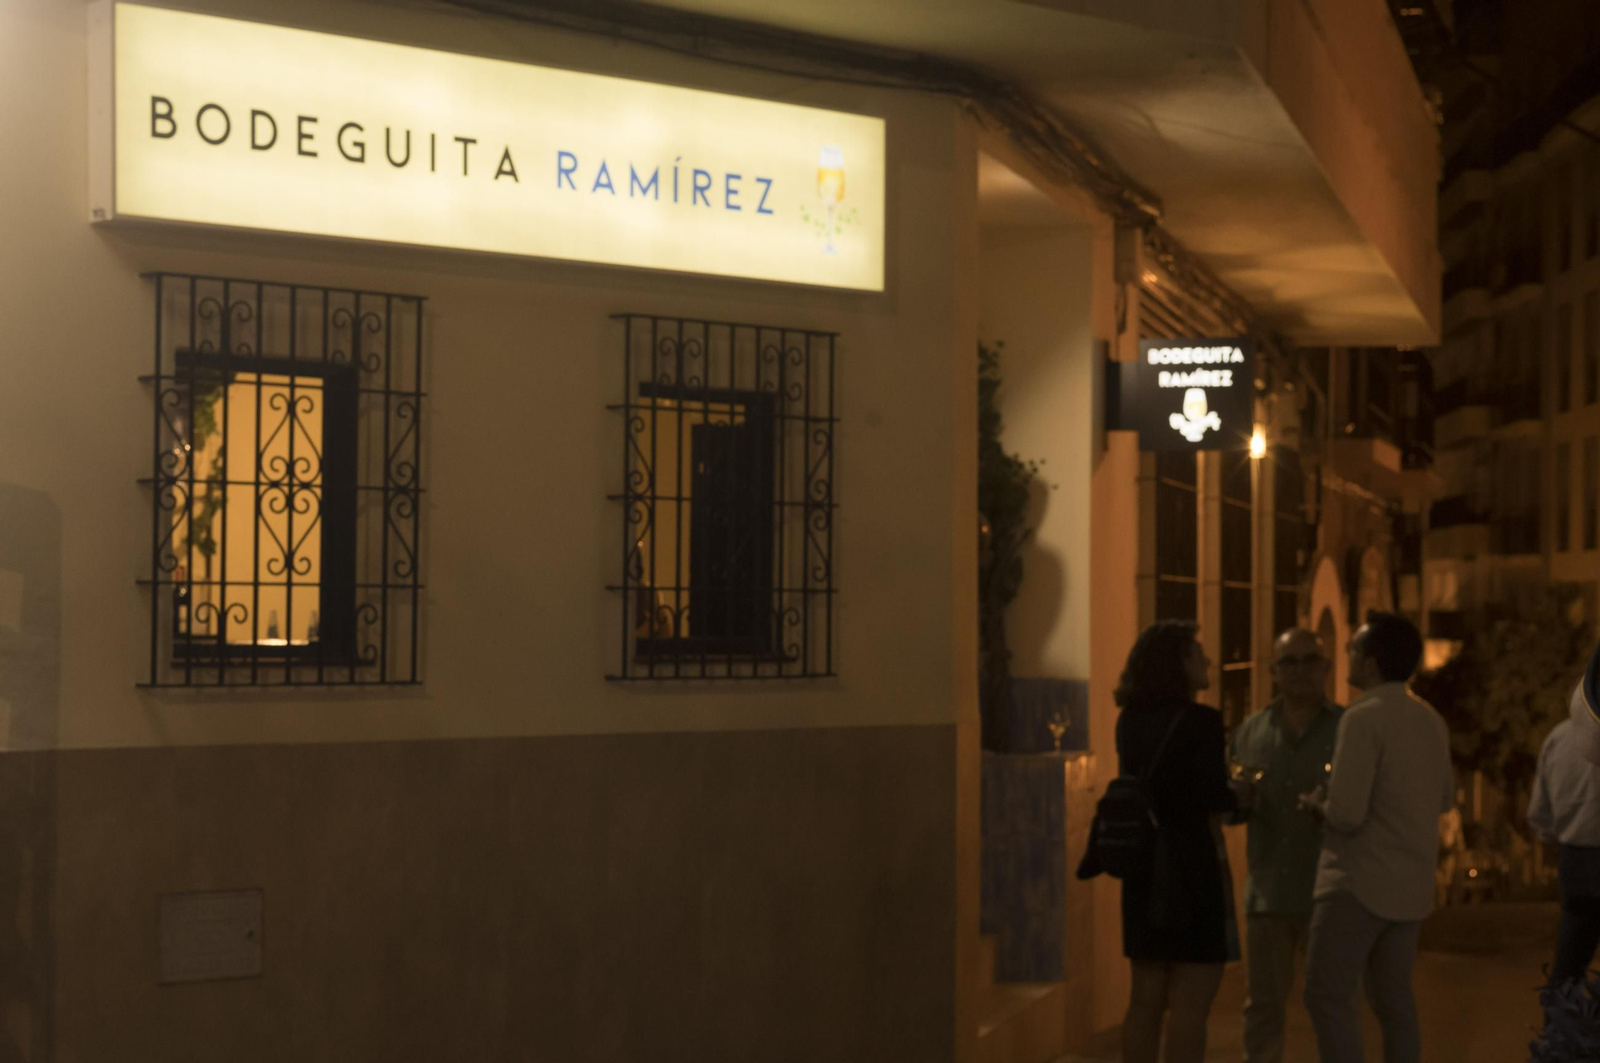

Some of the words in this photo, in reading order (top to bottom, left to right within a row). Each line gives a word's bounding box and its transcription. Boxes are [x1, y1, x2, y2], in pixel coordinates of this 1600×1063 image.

[150, 95, 519, 183] BODEGUITA
[557, 150, 775, 215] RAMÍREZ
[1147, 346, 1245, 365] BODEGUITA
[1158, 367, 1233, 388] RAMÍREZ
